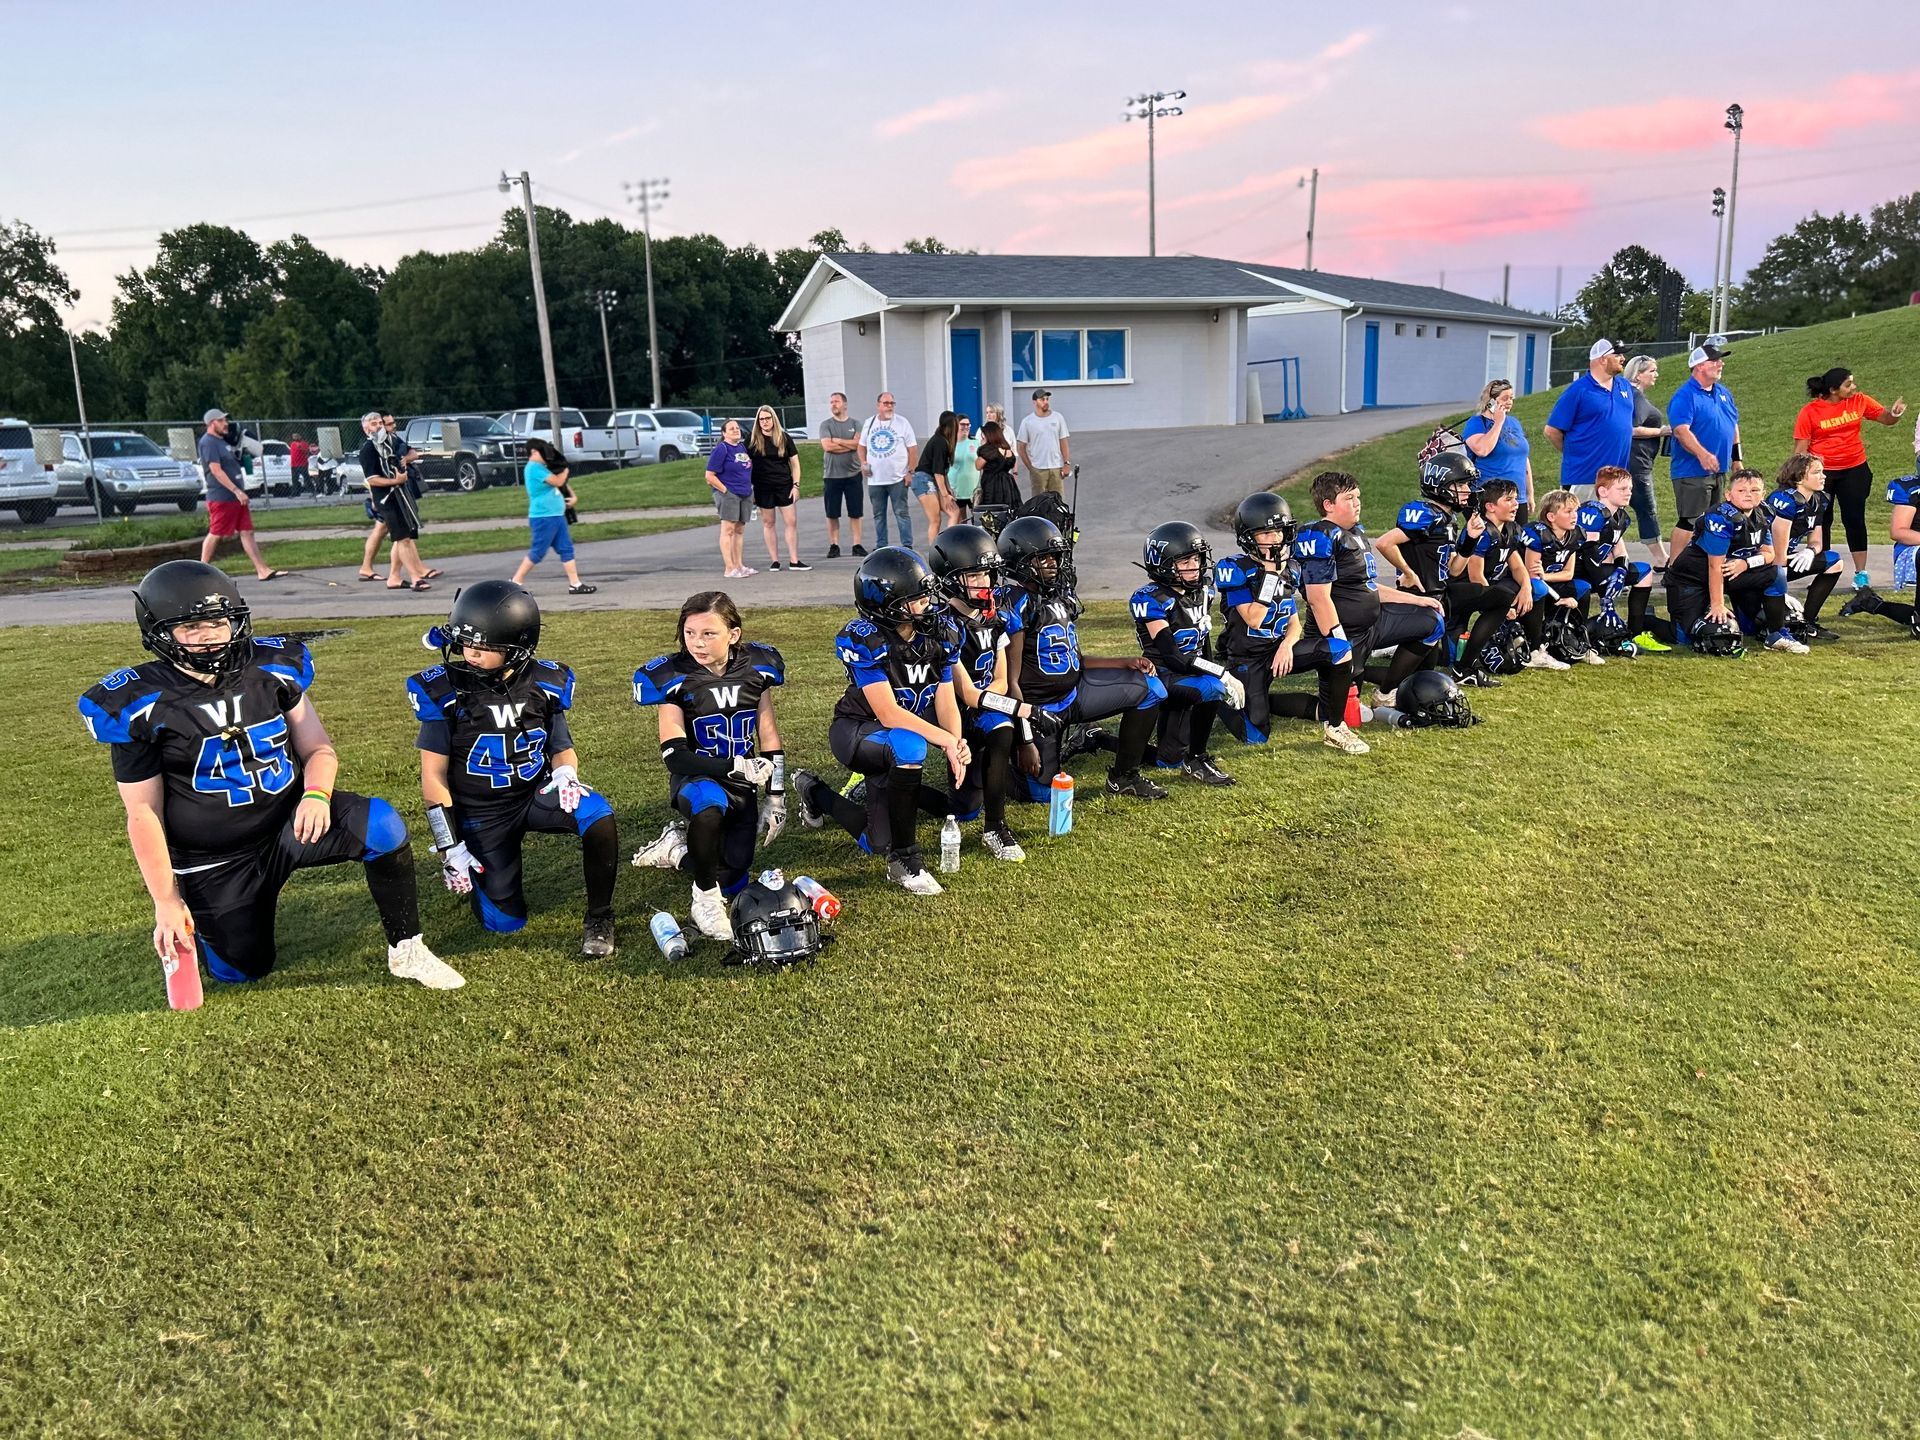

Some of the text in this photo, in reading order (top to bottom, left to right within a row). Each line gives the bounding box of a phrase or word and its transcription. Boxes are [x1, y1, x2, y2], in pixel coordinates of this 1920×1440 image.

[1773, 497, 1790, 510] W
[1405, 508, 1424, 523] W
[1581, 511, 1597, 526] W
[1807, 516, 1816, 529] W
[1520, 530, 1535, 546] W
[1750, 529, 1761, 545] W
[1298, 539, 1317, 556] W
[1499, 547, 1510, 562] W
[1555, 550, 1570, 563] W
[1218, 567, 1234, 583] W
[1046, 603, 1067, 620] W
[1132, 602, 1149, 618] W
[976, 629, 993, 650] W
[905, 663, 930, 684] W
[709, 685, 741, 709] W
[487, 702, 527, 728] W
[192, 713, 295, 808] 45
[466, 727, 547, 788] 43
